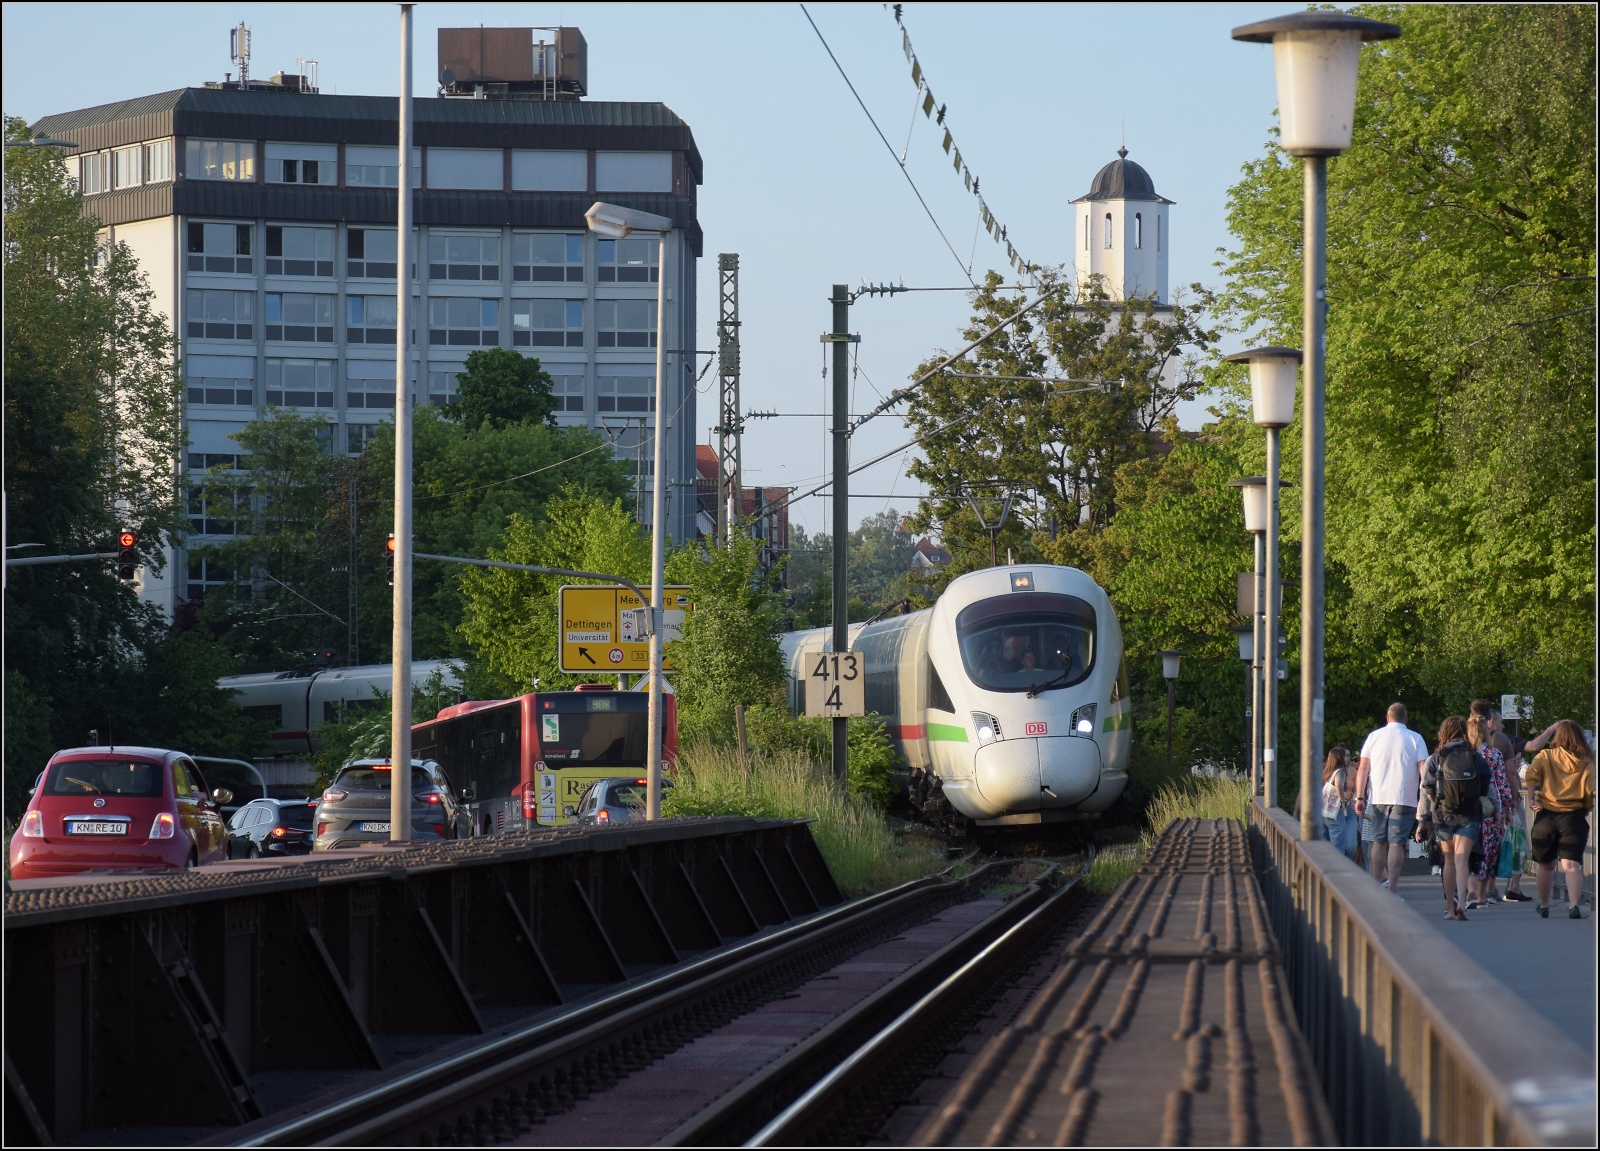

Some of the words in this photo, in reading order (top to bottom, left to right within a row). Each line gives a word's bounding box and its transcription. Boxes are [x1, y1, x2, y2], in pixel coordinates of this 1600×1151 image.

[620, 595, 672, 606] Meesrg
[566, 620, 612, 630] Dettingen
[635, 652, 645, 660] 33
[812, 655, 858, 682] 413
[825, 684, 843, 711] 4
[1028, 724, 1045, 733] DB
[566, 780, 593, 796] Ras
[76, 823, 90, 832] KN
[95, 823, 108, 832] RE
[109, 823, 122, 832] 10
